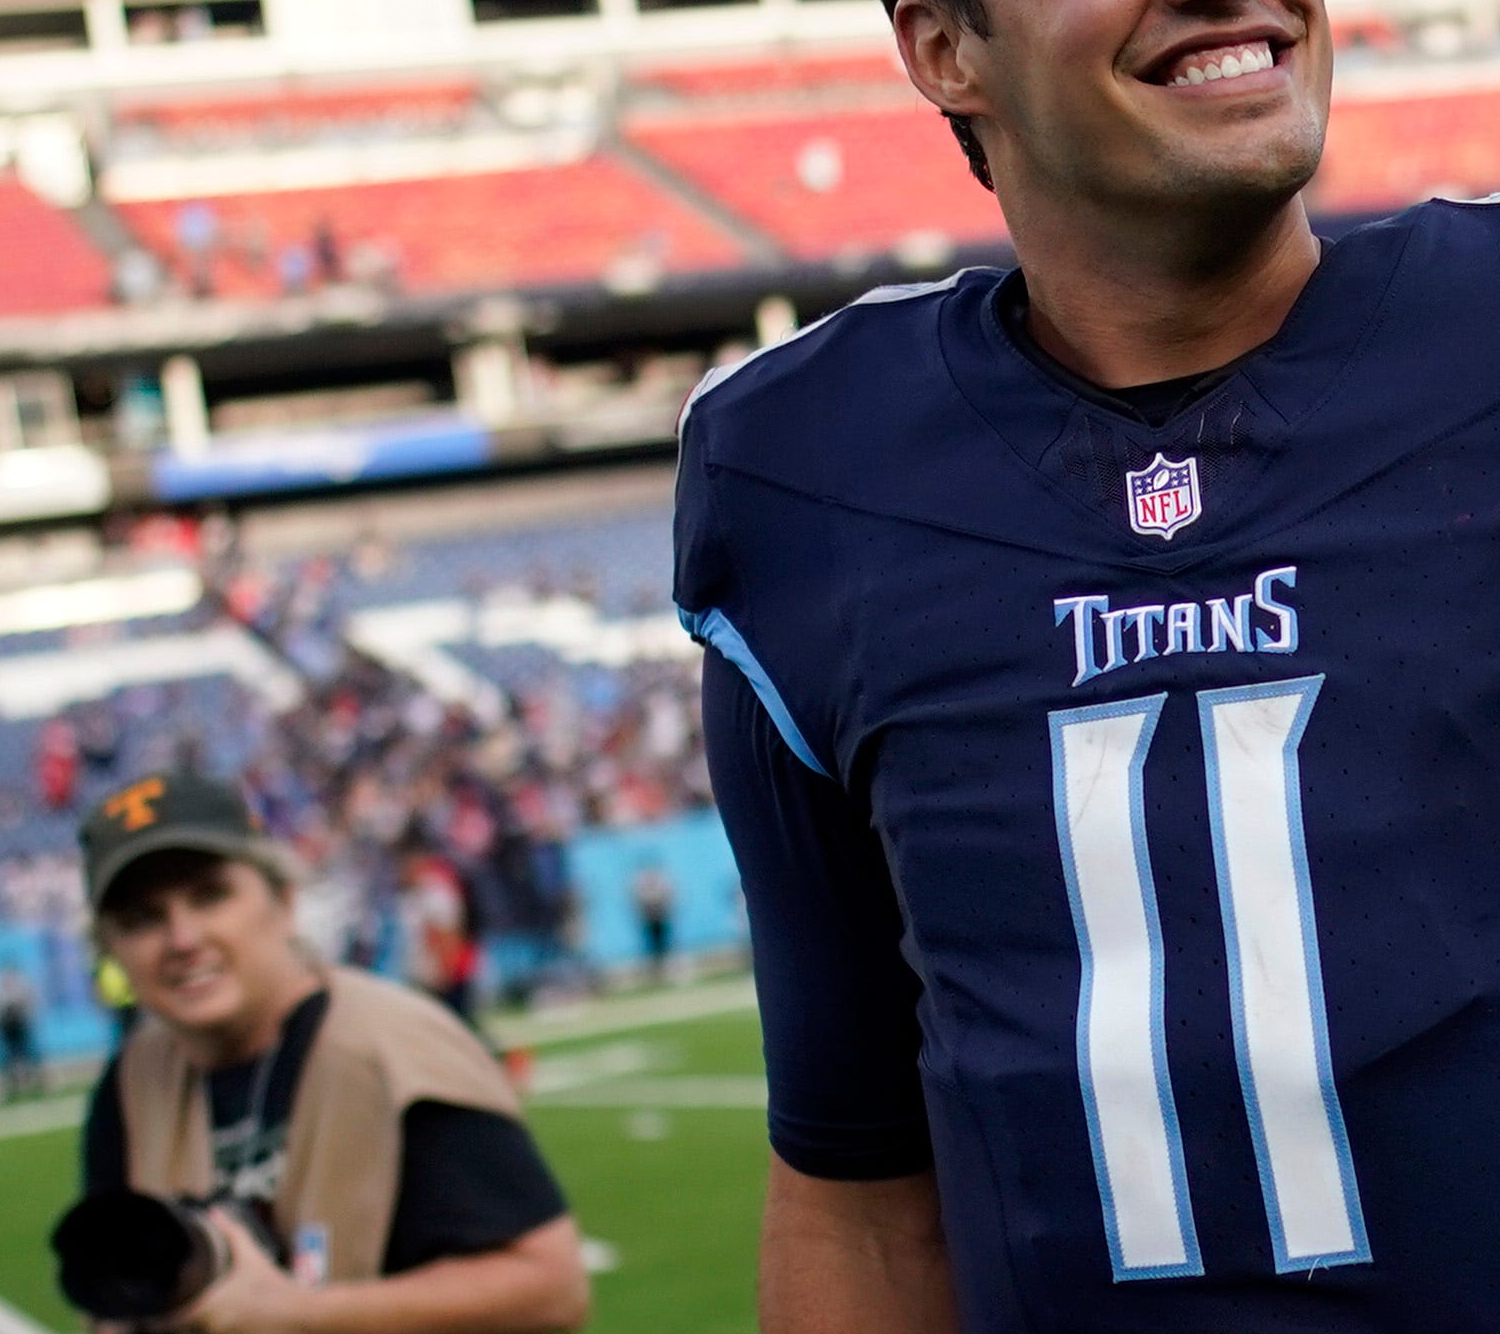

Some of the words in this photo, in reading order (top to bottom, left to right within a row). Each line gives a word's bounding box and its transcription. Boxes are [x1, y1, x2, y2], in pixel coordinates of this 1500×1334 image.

[1140, 489, 1189, 524] NFL
[1054, 567, 1299, 687] TITANS
[1047, 675, 1374, 1284] 11
